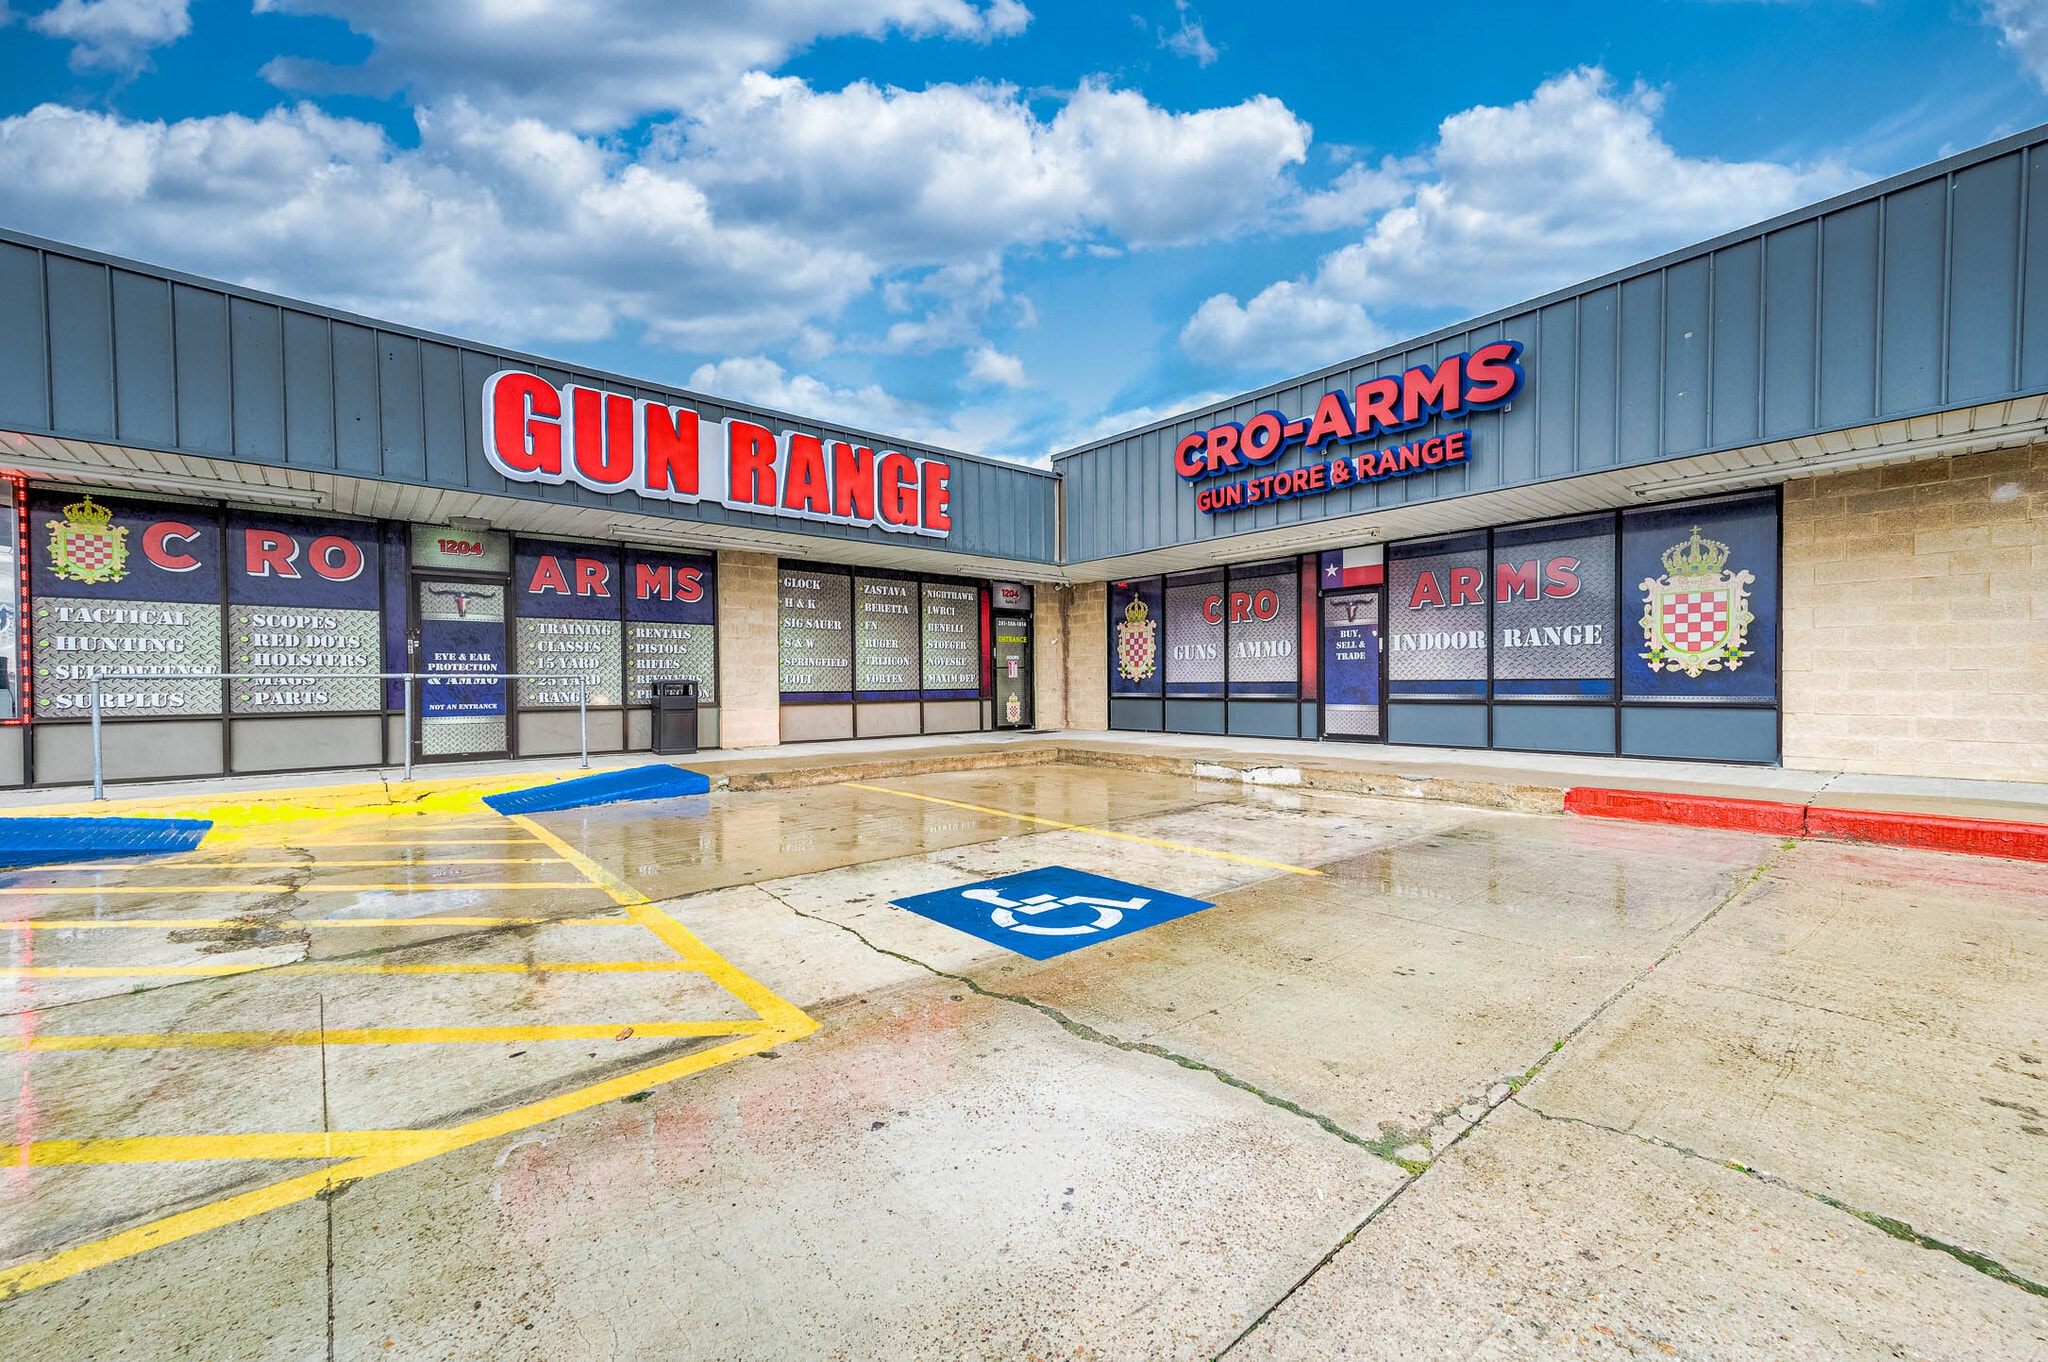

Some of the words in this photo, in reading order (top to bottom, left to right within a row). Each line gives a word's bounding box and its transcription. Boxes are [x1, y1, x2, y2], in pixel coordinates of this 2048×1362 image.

[1174, 343, 1520, 479] CRO-ARMS
[490, 372, 699, 498] GUN
[724, 419, 951, 533] RANGE
[1197, 484, 1242, 512] GUN
[1247, 464, 1325, 502] STORE
[1332, 459, 1349, 483] &
[1358, 432, 1465, 478] RANGE
[438, 539, 484, 556] 1204
[784, 578, 821, 590] GLOCK
[864, 585, 906, 597] ZASTAVA
[927, 590, 974, 601] NIGHTHAWK
[1001, 589, 1020, 599] 1204
[785, 598, 793, 608] H
[796, 599, 804, 608] &
[808, 600, 816, 609] K
[865, 603, 909, 614] BERETTA
[55, 606, 190, 626] TACTICAL
[927, 606, 955, 615] LWRCI
[252, 614, 338, 630] SCOPES
[784, 618, 803, 629] SIG
[806, 619, 841, 630] SAUER
[865, 621, 878, 630] FN
[538, 623, 611, 636] TRAINING
[928, 623, 964, 633] BENELLI
[636, 628, 692, 640] RENTALS
[1340, 630, 1361, 638] BUY,
[1393, 630, 1487, 651] INDOOR
[1504, 624, 1602, 647] RANGE
[55, 636, 185, 654] HUNTING
[253, 633, 300, 648] RED
[306, 635, 362, 649] DOTS
[784, 638, 792, 648] S
[795, 639, 803, 648] &
[806, 639, 815, 649] W
[865, 640, 899, 649] RUGER
[928, 641, 967, 650] STOEGER
[1336, 641, 1357, 649] SELL
[537, 641, 602, 653] CLASSES
[636, 643, 688, 655] PISTOLS
[1173, 644, 1217, 660] GUNS
[1236, 640, 1292, 658] AMMO
[253, 653, 369, 668] HOLSTERS
[434, 652, 456, 661] EYE
[458, 653, 467, 661] &
[469, 653, 491, 661] EAR
[865, 657, 910, 666] TRIJICON
[1336, 652, 1366, 660] TRADE
[427, 663, 498, 671] PROTECTION
[538, 657, 555, 669] 15
[558, 657, 600, 669] YARD
[636, 659, 681, 670] RIFLES
[784, 658, 848, 667] SPRINGFIELD
[929, 658, 967, 666] NOVESKE
[785, 675, 812, 684] COLT
[866, 675, 904, 683] VORTEX
[55, 693, 186, 710] SURPLUS
[254, 691, 329, 705] PARTS
